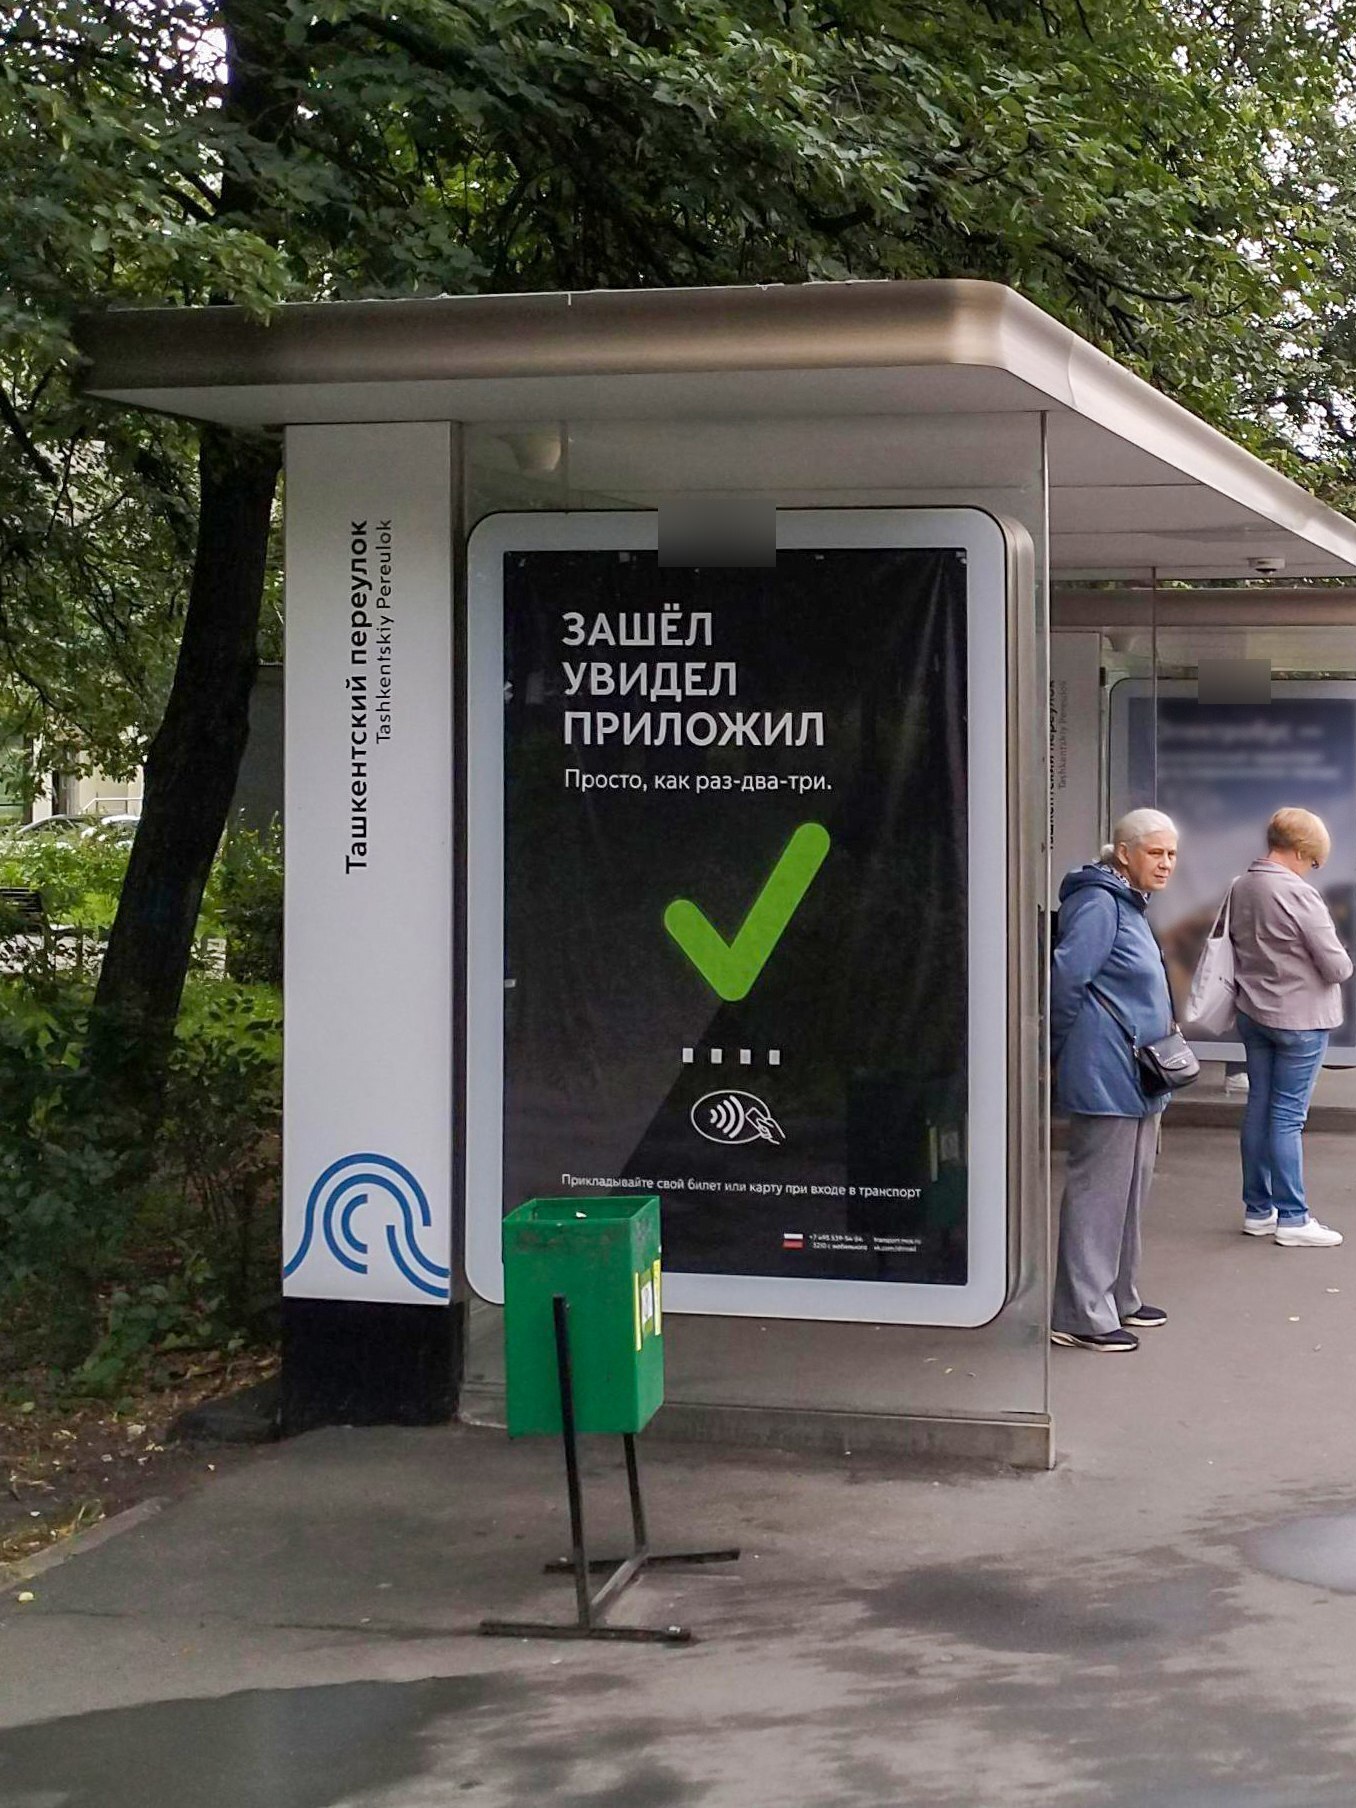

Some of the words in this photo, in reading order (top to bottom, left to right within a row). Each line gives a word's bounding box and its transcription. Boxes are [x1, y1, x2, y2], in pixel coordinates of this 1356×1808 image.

[376, 519, 392, 609] Pereulok
[351, 520, 372, 665] переулок
[561, 602, 712, 646] ЗАШЁЛ
[376, 615, 394, 745] Tashkentskiy
[562, 662, 737, 702] УВИДЕЛ
[564, 711, 825, 747] ПРИЛОЖИЛ
[345, 675, 367, 874] Ташкентский
[565, 768, 648, 792] Просто,
[654, 774, 690, 790] как
[696, 773, 832, 794] раз-два-три.
[562, 1173, 653, 1189] Прикладывайте
[657, 1177, 685, 1190] свой
[688, 1177, 723, 1192] билет
[725, 1182, 746, 1192] или
[750, 1182, 782, 1196] карту
[786, 1185, 808, 1195] при
[811, 1185, 845, 1196] входе
[849, 1187, 856, 1196] в
[859, 1187, 922, 1199] транспорт
